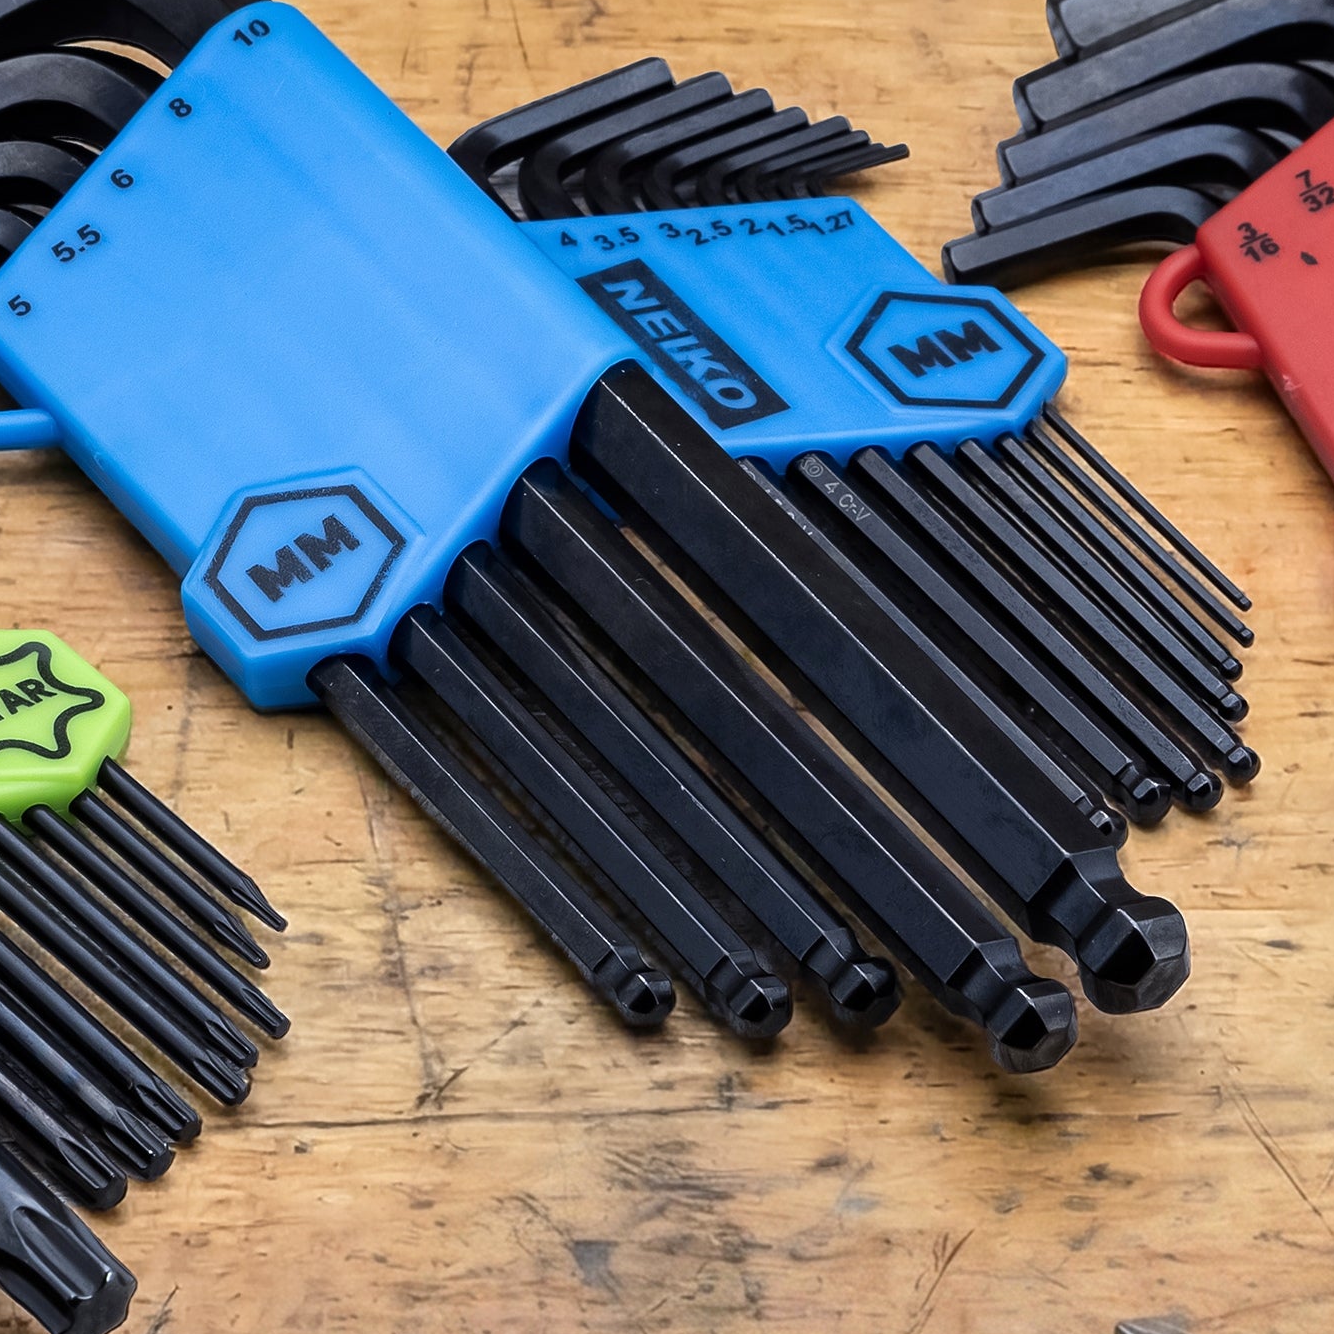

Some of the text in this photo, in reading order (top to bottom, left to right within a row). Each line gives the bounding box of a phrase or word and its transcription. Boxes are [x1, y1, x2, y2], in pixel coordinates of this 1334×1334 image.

[232, 18, 272, 48] 10
[168, 97, 193, 118] 8
[110, 168, 135, 190] 6
[50, 224, 102, 263] 5.5
[560, 231, 578, 248] 4
[594, 226, 641, 252] 3.5
[685, 220, 733, 247] 2.5
[738, 217, 764, 235] 2
[766, 213, 810, 237] 1.5
[806, 210, 855, 235] 1.27
[7, 294, 32, 317] 5
[602, 278, 758, 410] NEIKO
[888, 320, 1004, 378] MM
[824, 481, 871, 522] 4 Cr-V
[245, 514, 360, 604] MM
